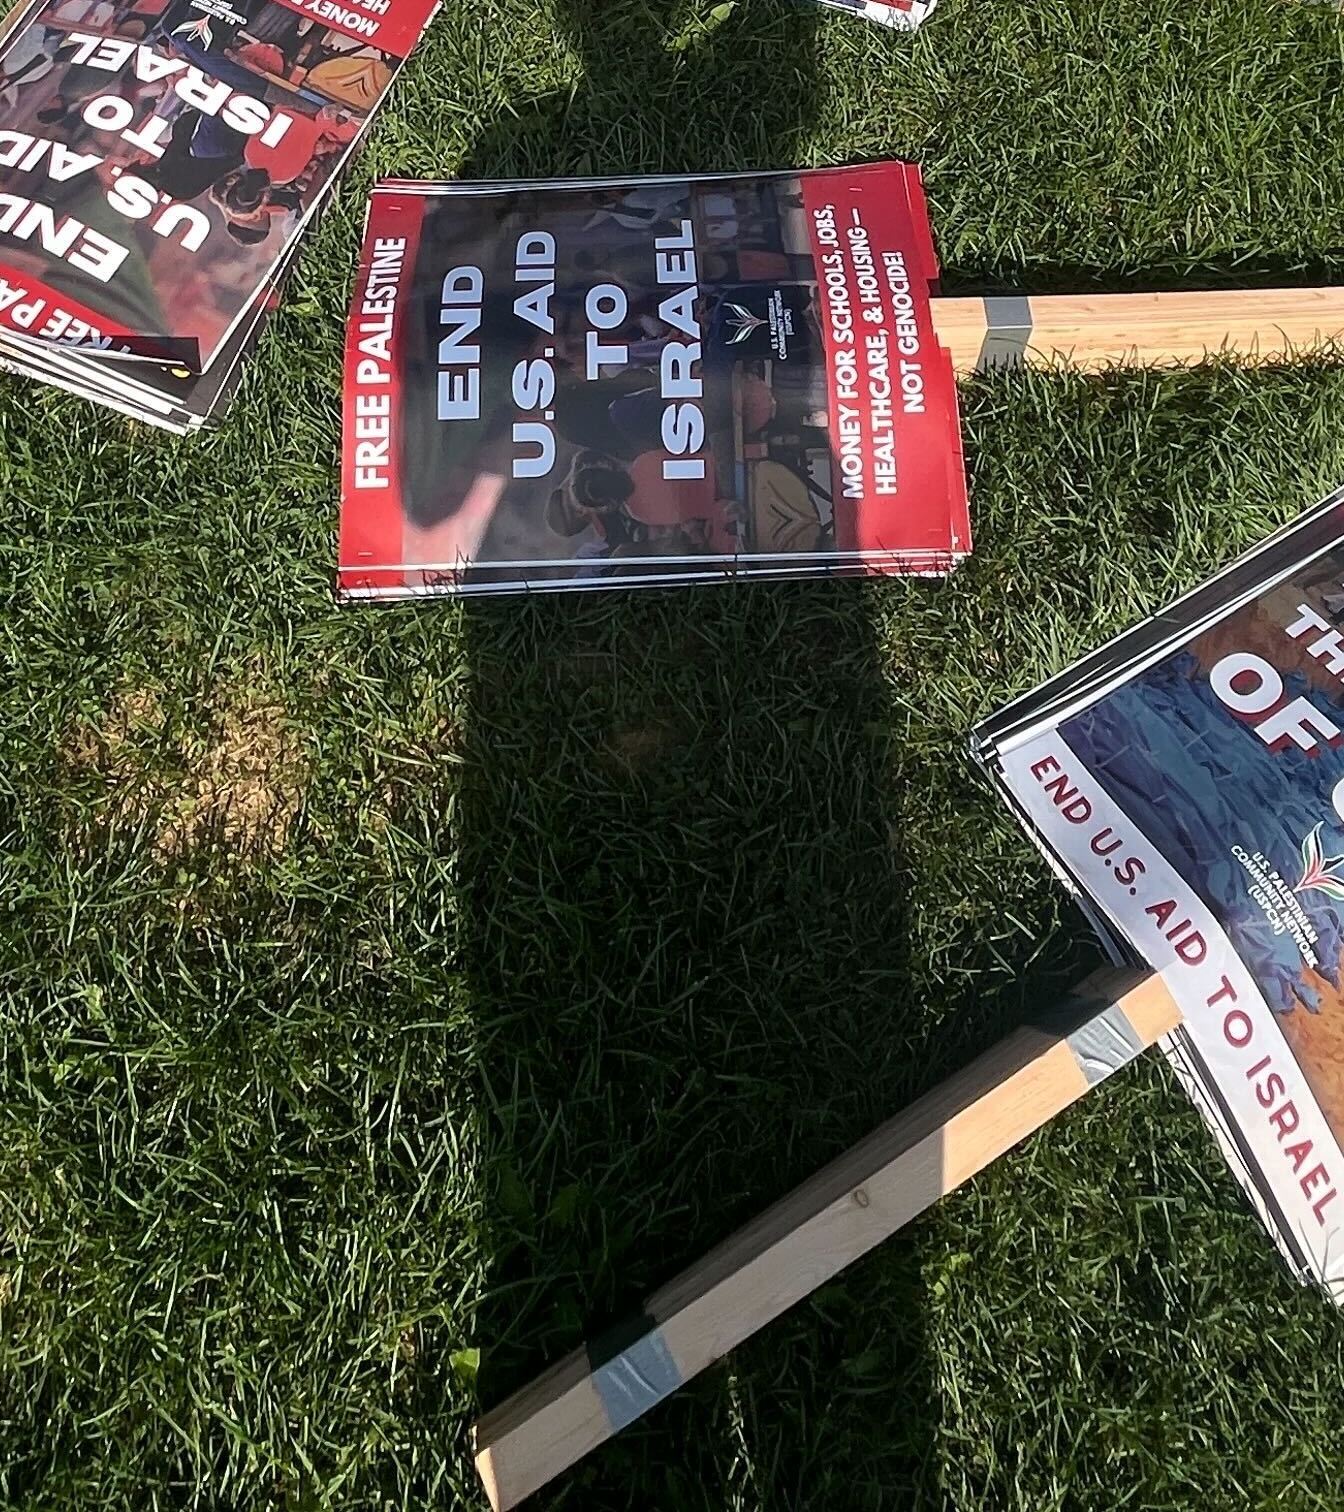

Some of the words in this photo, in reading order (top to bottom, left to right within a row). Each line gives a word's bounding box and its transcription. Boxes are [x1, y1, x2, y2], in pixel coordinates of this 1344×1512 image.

[65, 31, 294, 152] ISRAEL
[82, 93, 166, 159] TO
[105, 165, 213, 254] U.S.
[814, 203, 837, 248] JOBS,
[363, 236, 407, 384] PALESTINE
[513, 231, 557, 334] AID
[584, 283, 629, 381] TO
[822, 249, 855, 344] SCHOOLS,
[863, 304, 884, 323] &
[882, 251, 920, 356] GENOCIDE!
[437, 265, 484, 421] END
[655, 219, 706, 481] ISRAEL
[835, 348, 859, 399] FOR
[902, 360, 925, 413] NOT
[354, 395, 390, 489] FREE
[512, 347, 557, 479] U.S.
[838, 404, 864, 499] MONEY
[866, 329, 897, 496] HEALTHCARE,
[1208, 651, 1343, 760] OF
[1231, 846, 1285, 909] COMMUNITY
[1281, 910, 1318, 969] NETWORK
[1252, 852, 1270, 873] U.S.
[1268, 872, 1318, 944] PALESTINIAN
[1028, 753, 1093, 826] END
[1088, 829, 1146, 897] U.S.
[1144, 897, 1208, 969] AID
[1204, 976, 1255, 1051] TO
[1248, 1066, 1343, 1227] ISRAEL
